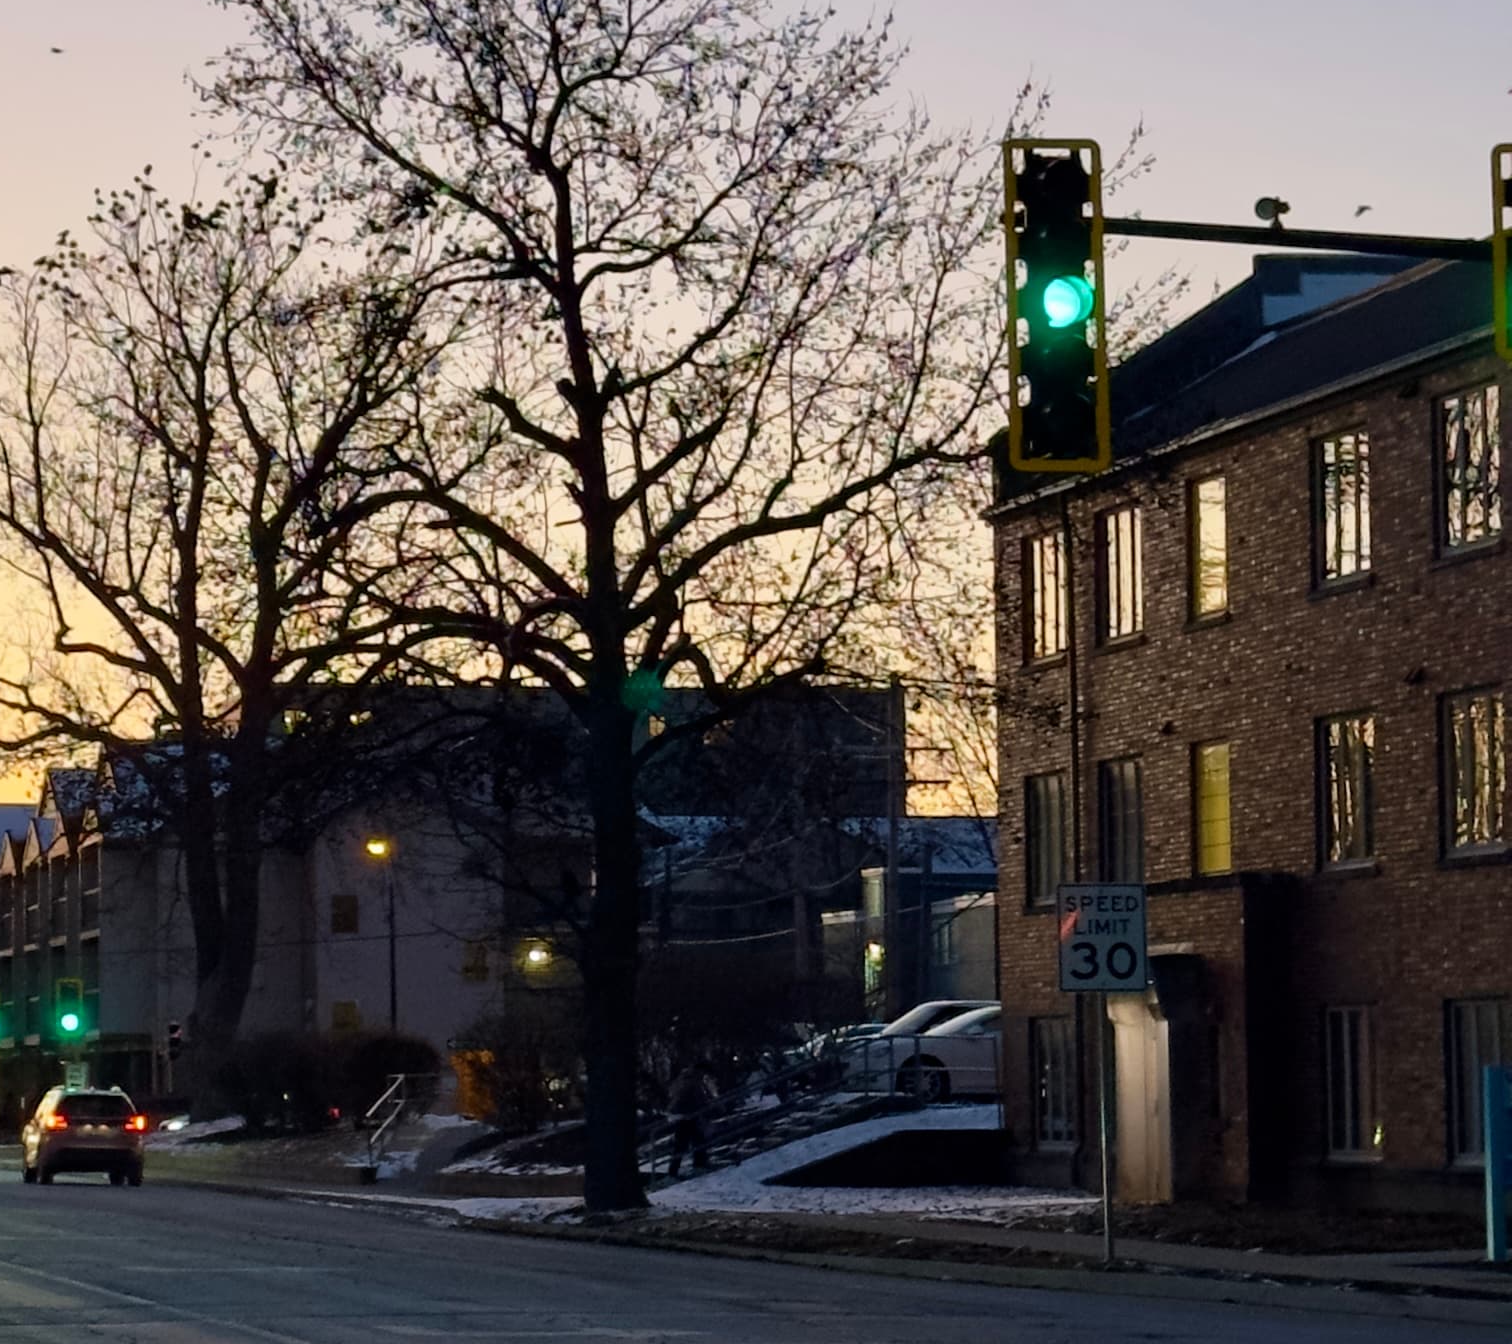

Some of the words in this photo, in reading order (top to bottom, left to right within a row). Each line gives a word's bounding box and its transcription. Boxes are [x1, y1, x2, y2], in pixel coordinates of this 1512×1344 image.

[1066, 896, 1139, 912] SPEED
[1074, 919, 1130, 935] LIMIT
[1070, 942, 1137, 980] 30
